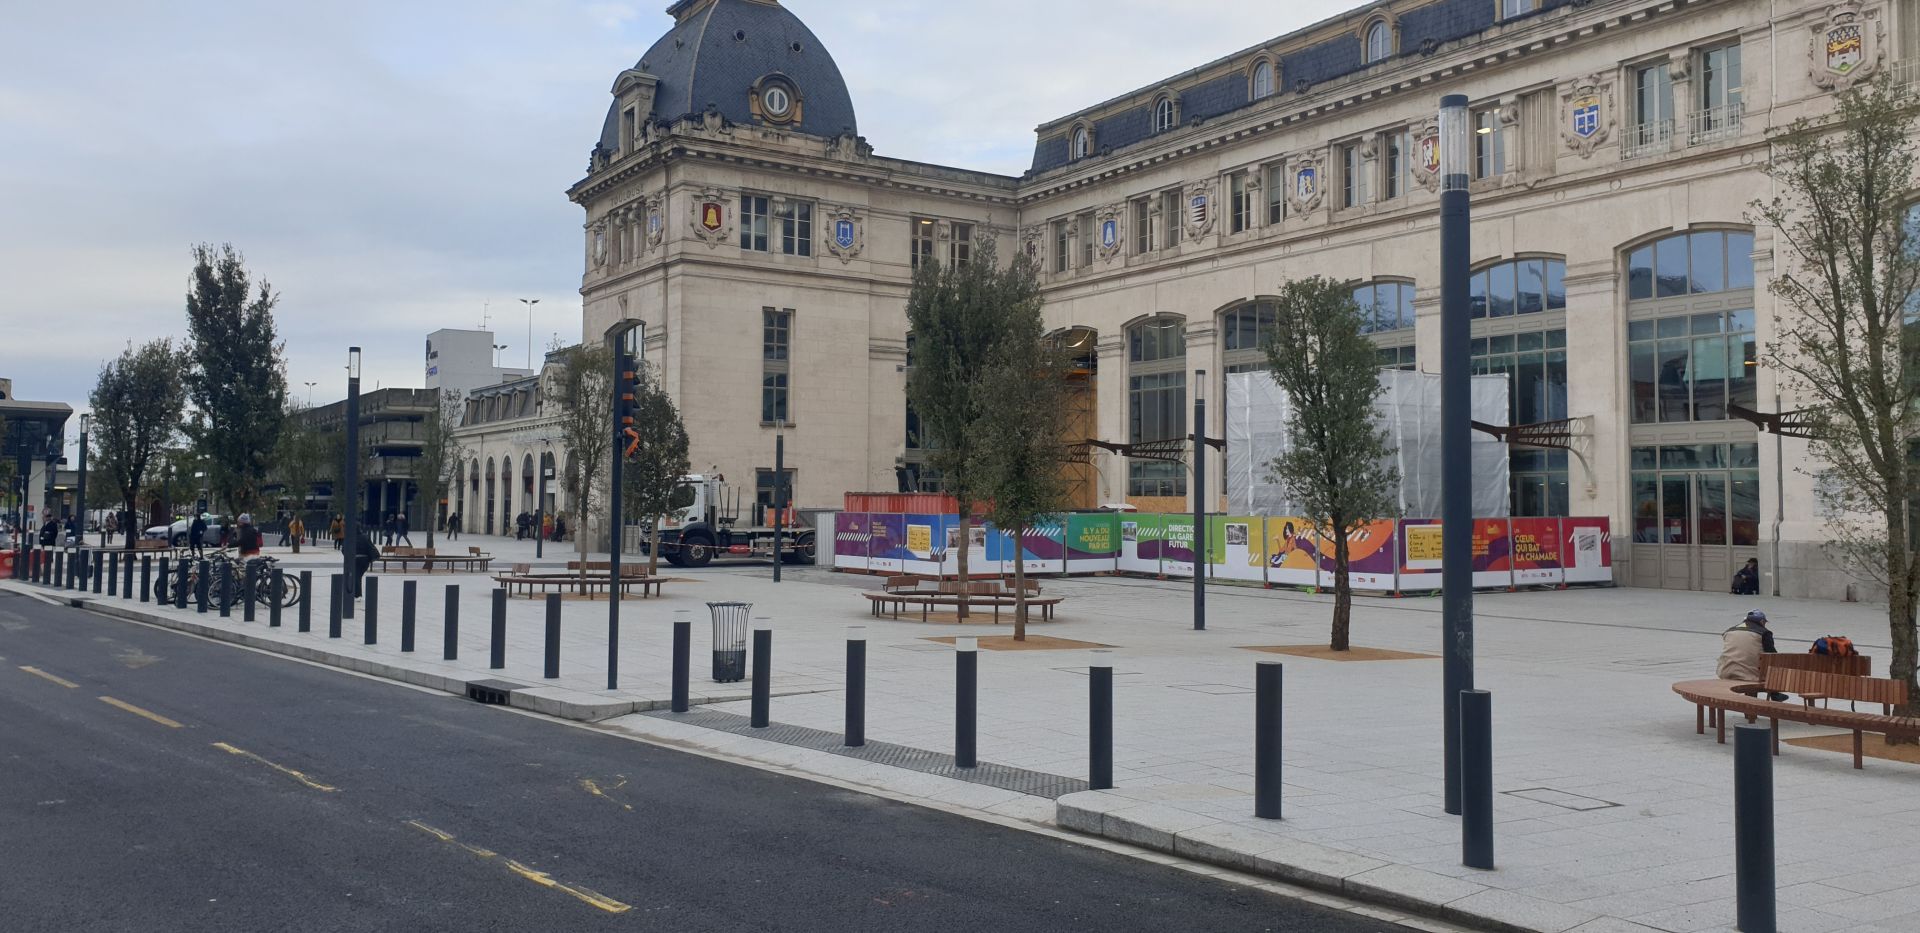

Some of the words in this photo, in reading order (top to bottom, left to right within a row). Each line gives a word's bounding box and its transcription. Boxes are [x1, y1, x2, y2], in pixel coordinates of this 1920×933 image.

[1168, 524, 1194, 533] DIRECTIO
[1079, 535, 1109, 543] NOUVEAU
[1168, 532, 1177, 540] LA
[1177, 533, 1194, 541] GARE
[1515, 534, 1535, 543] CŒUR
[1168, 540, 1188, 548] FUTUR
[1515, 543, 1528, 552] QUI
[1528, 543, 1540, 552] BAT
[1516, 553, 1525, 561] LA
[1525, 552, 1557, 561] CHAMADE
